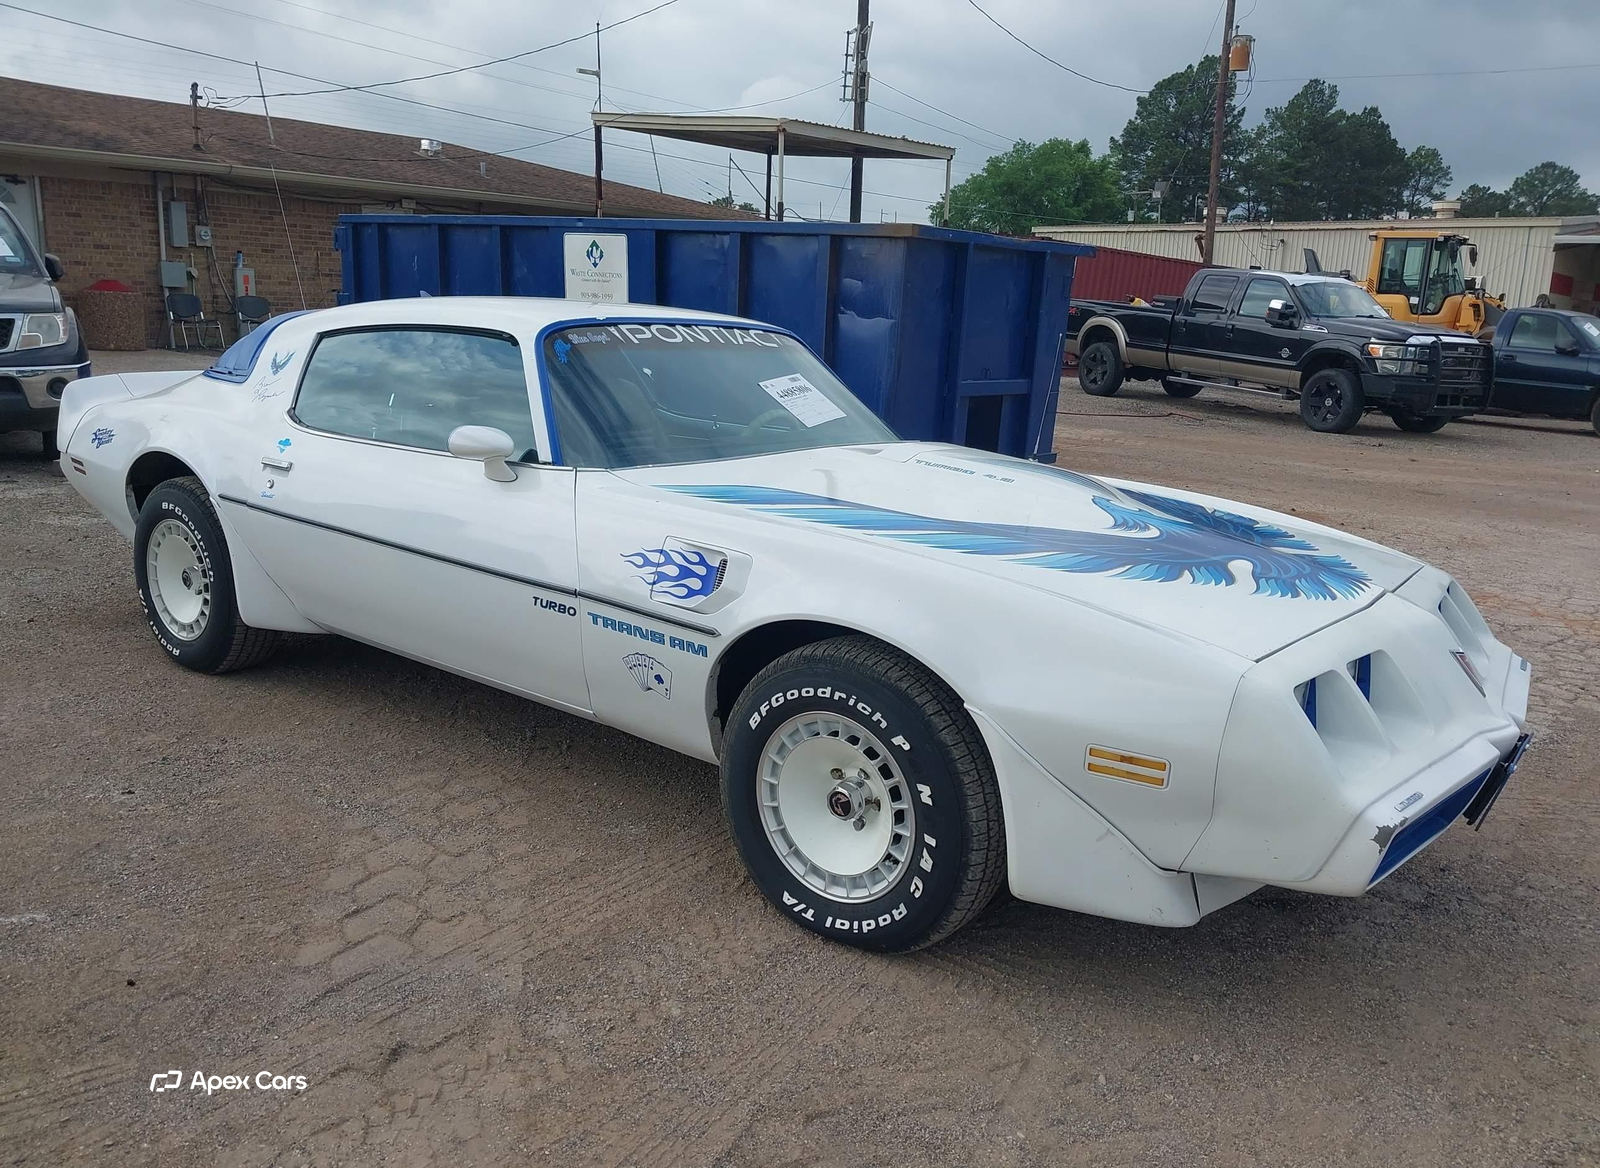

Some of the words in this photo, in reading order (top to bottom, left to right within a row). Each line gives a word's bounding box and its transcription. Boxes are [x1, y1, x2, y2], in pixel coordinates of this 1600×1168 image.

[617, 323, 779, 348] PONTIAC
[914, 458, 976, 476] TURBO
[161, 501, 215, 583] BFGoodrich
[532, 595, 577, 617] TURBO
[148, 620, 181, 657] Radial
[587, 611, 666, 646] TRANS
[669, 635, 709, 659] AM
[748, 686, 889, 731] BFGoodrich
[781, 890, 816, 922] T/A
[824, 902, 908, 934] Radial
